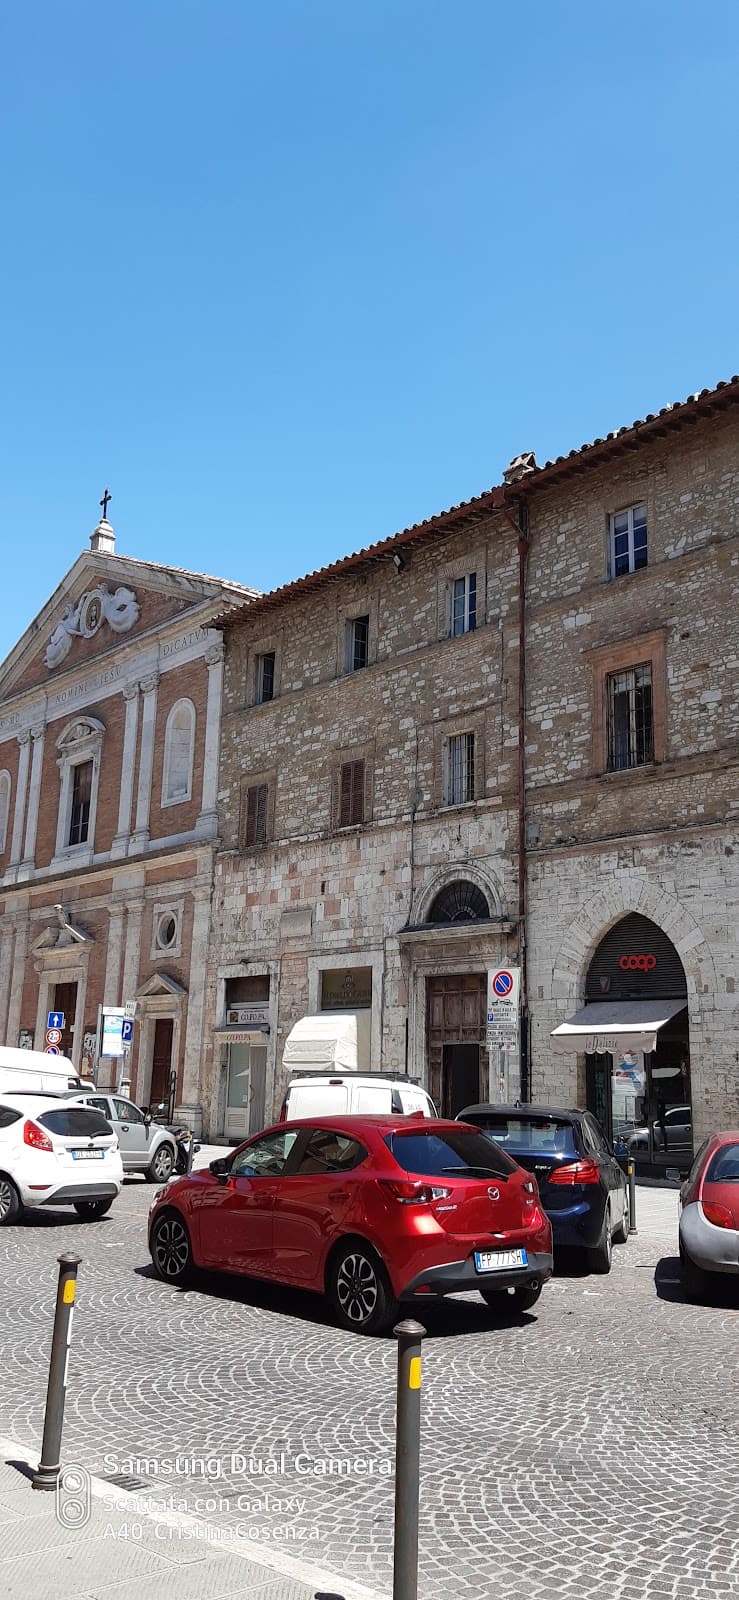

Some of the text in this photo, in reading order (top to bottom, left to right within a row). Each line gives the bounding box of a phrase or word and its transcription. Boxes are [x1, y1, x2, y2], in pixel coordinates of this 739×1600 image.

[163, 628, 209, 656] DICATVM
[619, 954, 657, 972] coop
[123, 1023, 131, 1038] P
[481, 1250, 522, 1266] FP 777SH
